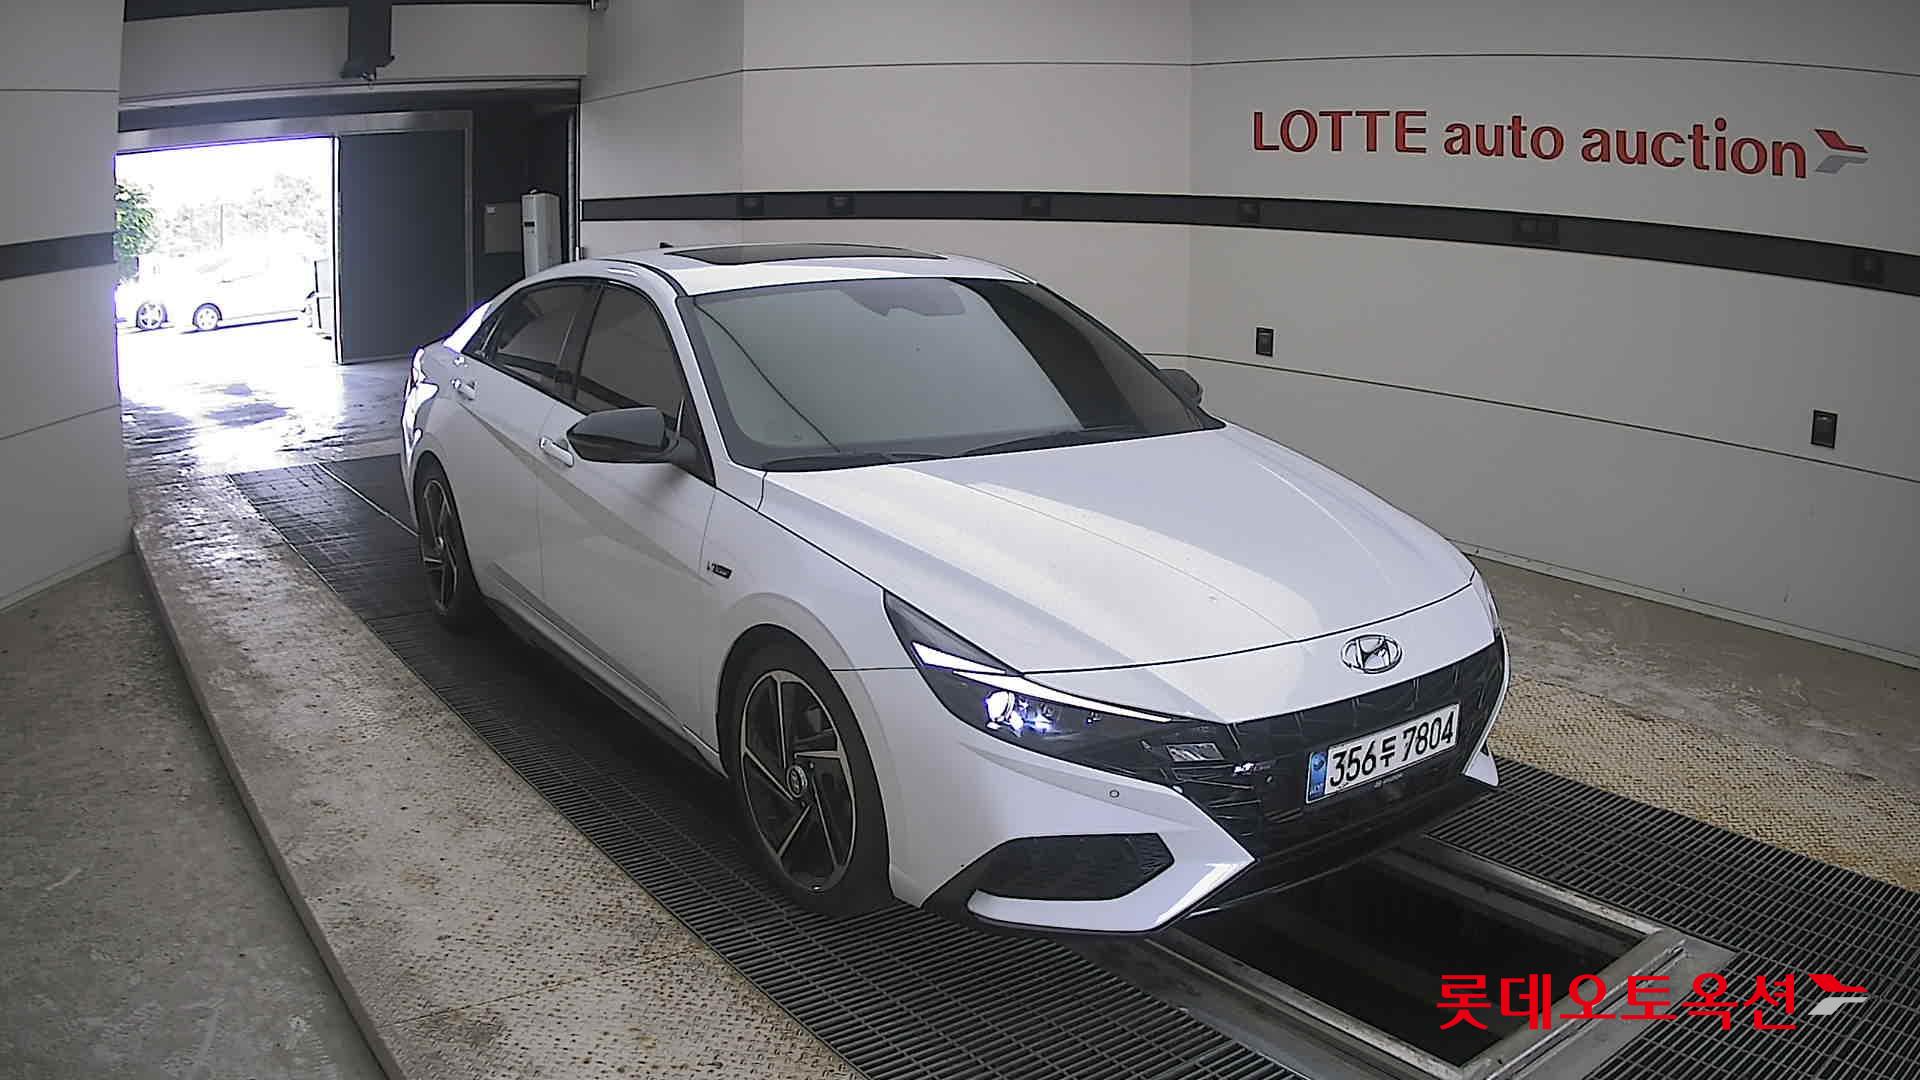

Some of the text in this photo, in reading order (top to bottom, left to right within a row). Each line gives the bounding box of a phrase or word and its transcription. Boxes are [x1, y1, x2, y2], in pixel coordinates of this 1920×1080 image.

[1254, 110, 1807, 179] LOTTE auto auction
